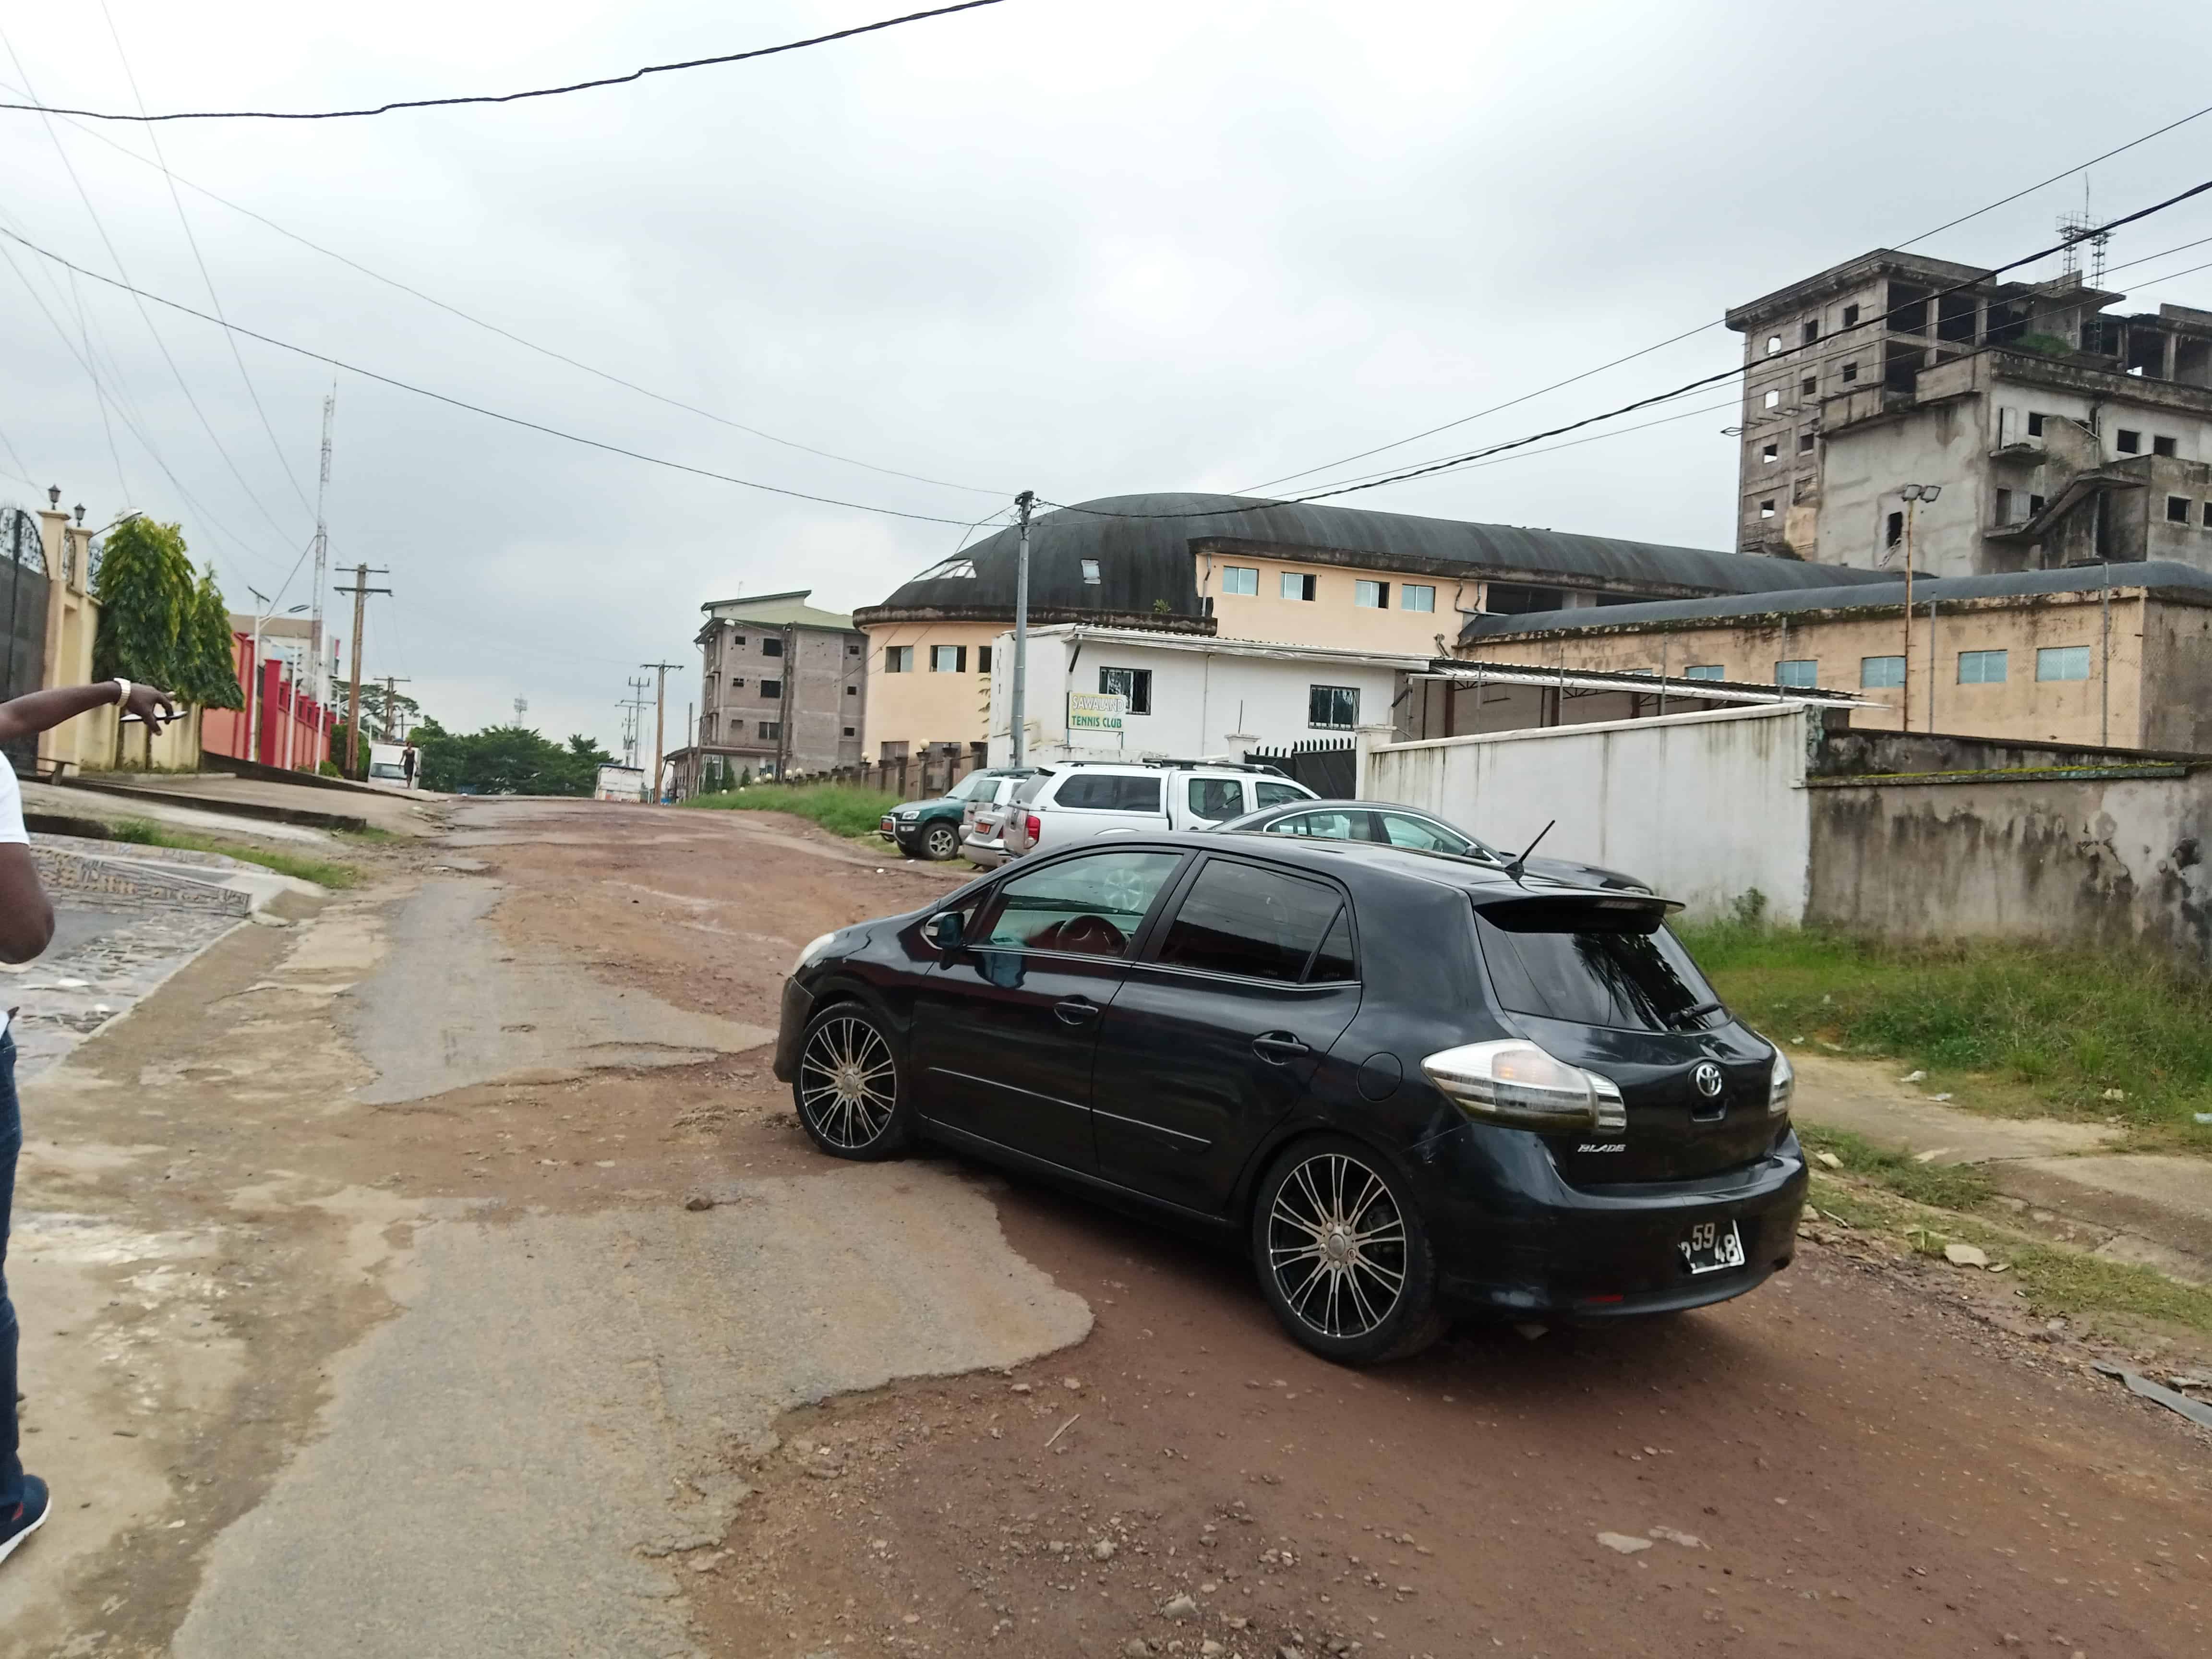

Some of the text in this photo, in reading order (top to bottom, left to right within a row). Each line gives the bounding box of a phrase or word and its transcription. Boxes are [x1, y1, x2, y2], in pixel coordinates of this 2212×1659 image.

[1072, 695, 1124, 712] SAWALAND
[1071, 715, 1122, 728] TENNIS CLUB
[1577, 1144, 1626, 1153] BLADE
